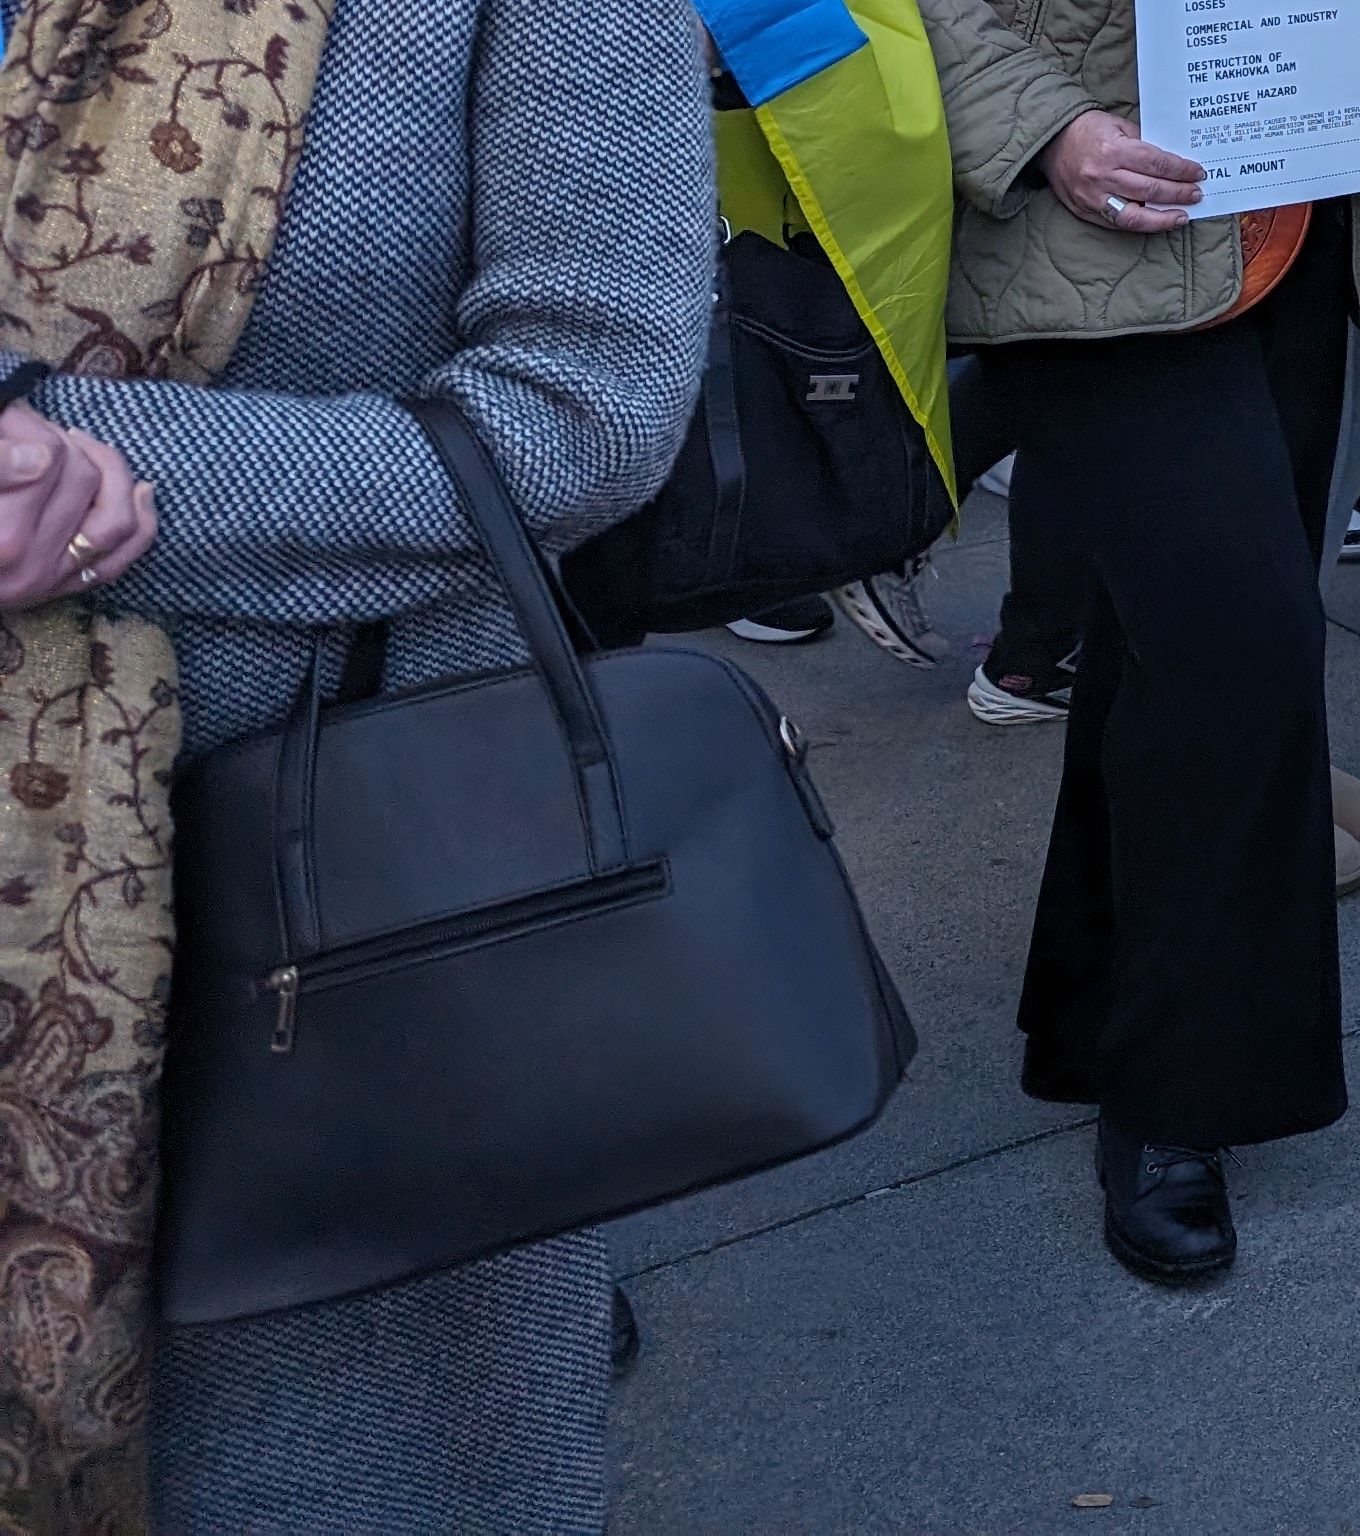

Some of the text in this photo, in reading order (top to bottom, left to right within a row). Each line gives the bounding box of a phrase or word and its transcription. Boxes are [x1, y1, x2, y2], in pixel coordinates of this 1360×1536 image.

[1185, 0, 1225, 12] LOSSES
[1186, 9, 1338, 36] COMMERCIAL AND INDUSTRY
[1187, 35, 1227, 48] LOSSES
[1188, 51, 1282, 72] DESTRUCTION OF
[1188, 62, 1296, 84] THE KAKHOVKA DAM
[1189, 84, 1297, 108] EXPLOSIVE HAZARD
[1190, 102, 1257, 120] MANAGEMENT
[1239, 158, 1285, 175] AMOUNT
